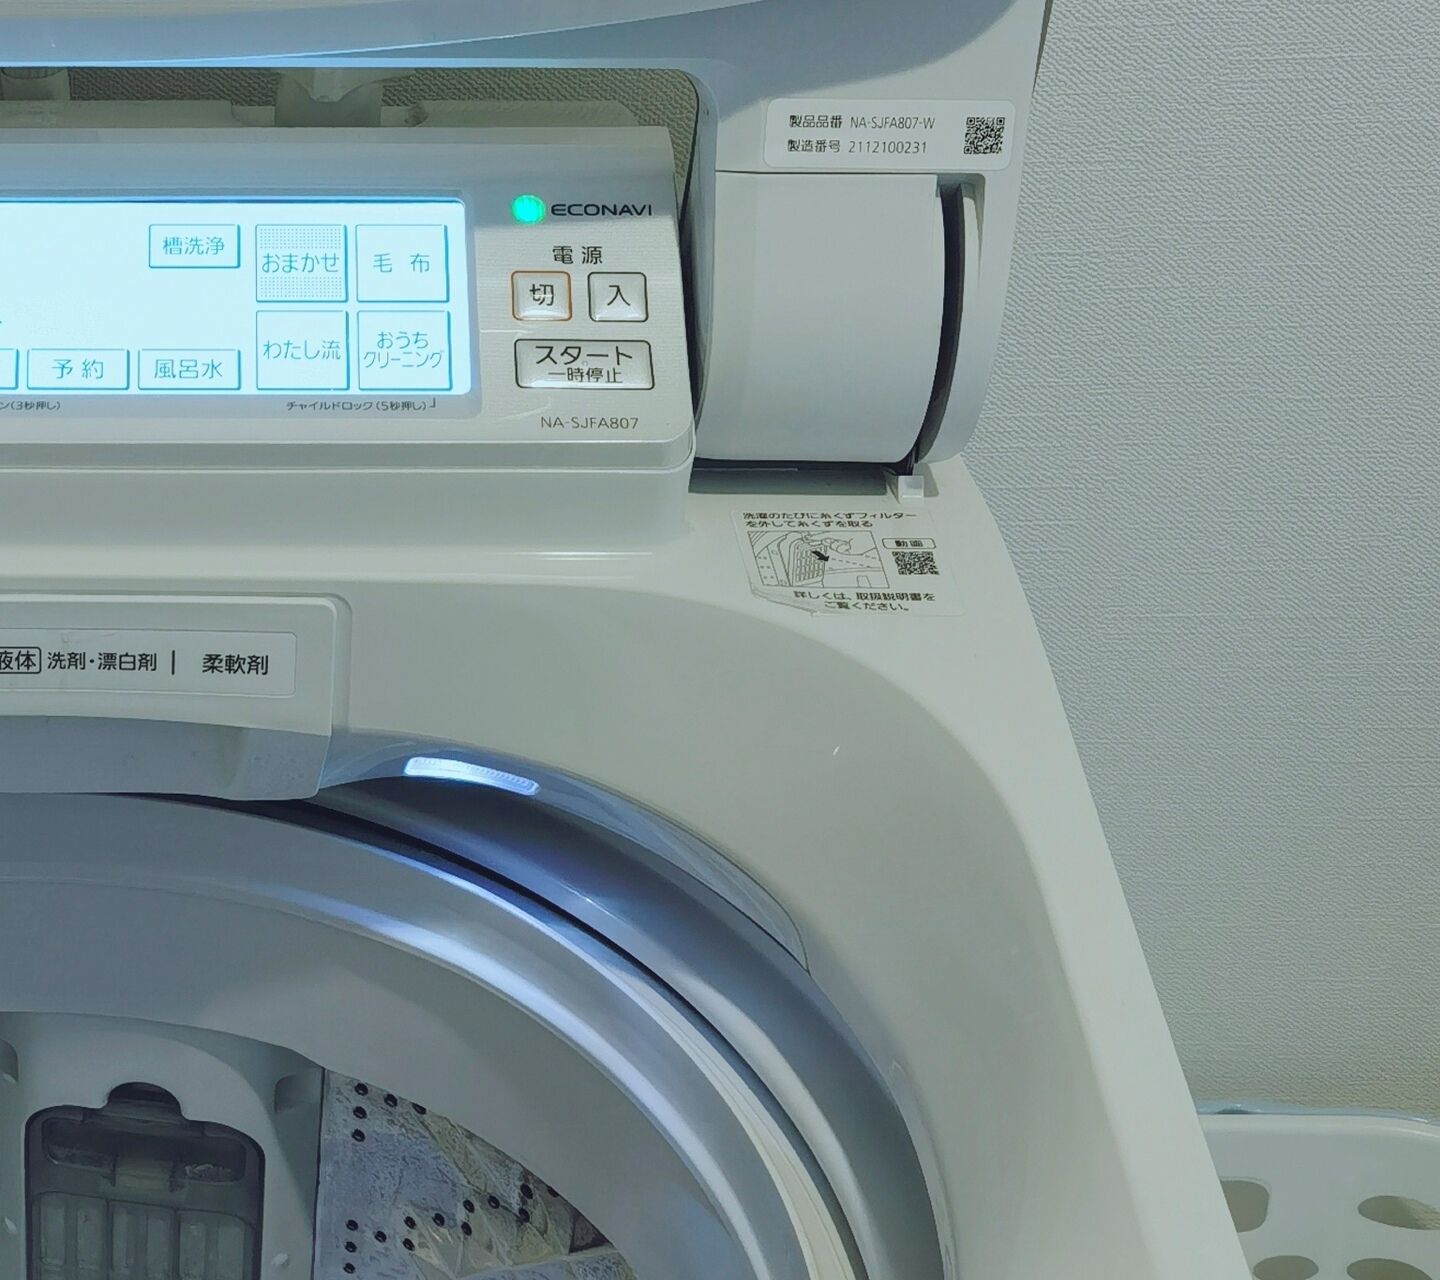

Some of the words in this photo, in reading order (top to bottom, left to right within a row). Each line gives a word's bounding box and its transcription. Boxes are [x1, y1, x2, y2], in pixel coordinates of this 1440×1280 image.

[789, 115, 842, 128] 製品品番
[850, 117, 935, 129] NA-SJFA807-W
[788, 140, 841, 153] 製造番号
[849, 141, 927, 153] 2112100231
[551, 204, 652, 216] ECONAVI
[163, 236, 225, 256] 槽洗浄
[553, 246, 602, 264] 電源
[261, 253, 340, 273] おまかせ
[373, 253, 431, 273] 毛布
[530, 284, 554, 306] 切
[607, 285, 630, 306] 入
[263, 340, 341, 360] わたし流
[377, 332, 429, 349] おうち
[363, 350, 442, 369] クリーニング
[535, 346, 632, 364] スタート
[52, 359, 104, 379] 予約
[154, 359, 222, 379] 風呂水
[548, 368, 622, 383] 一時停止
[541, 417, 639, 429] NA-SJFA807
[47, 652, 157, 671] 洗剤・漂白剤
[202, 654, 269, 675] 柔軟剤
